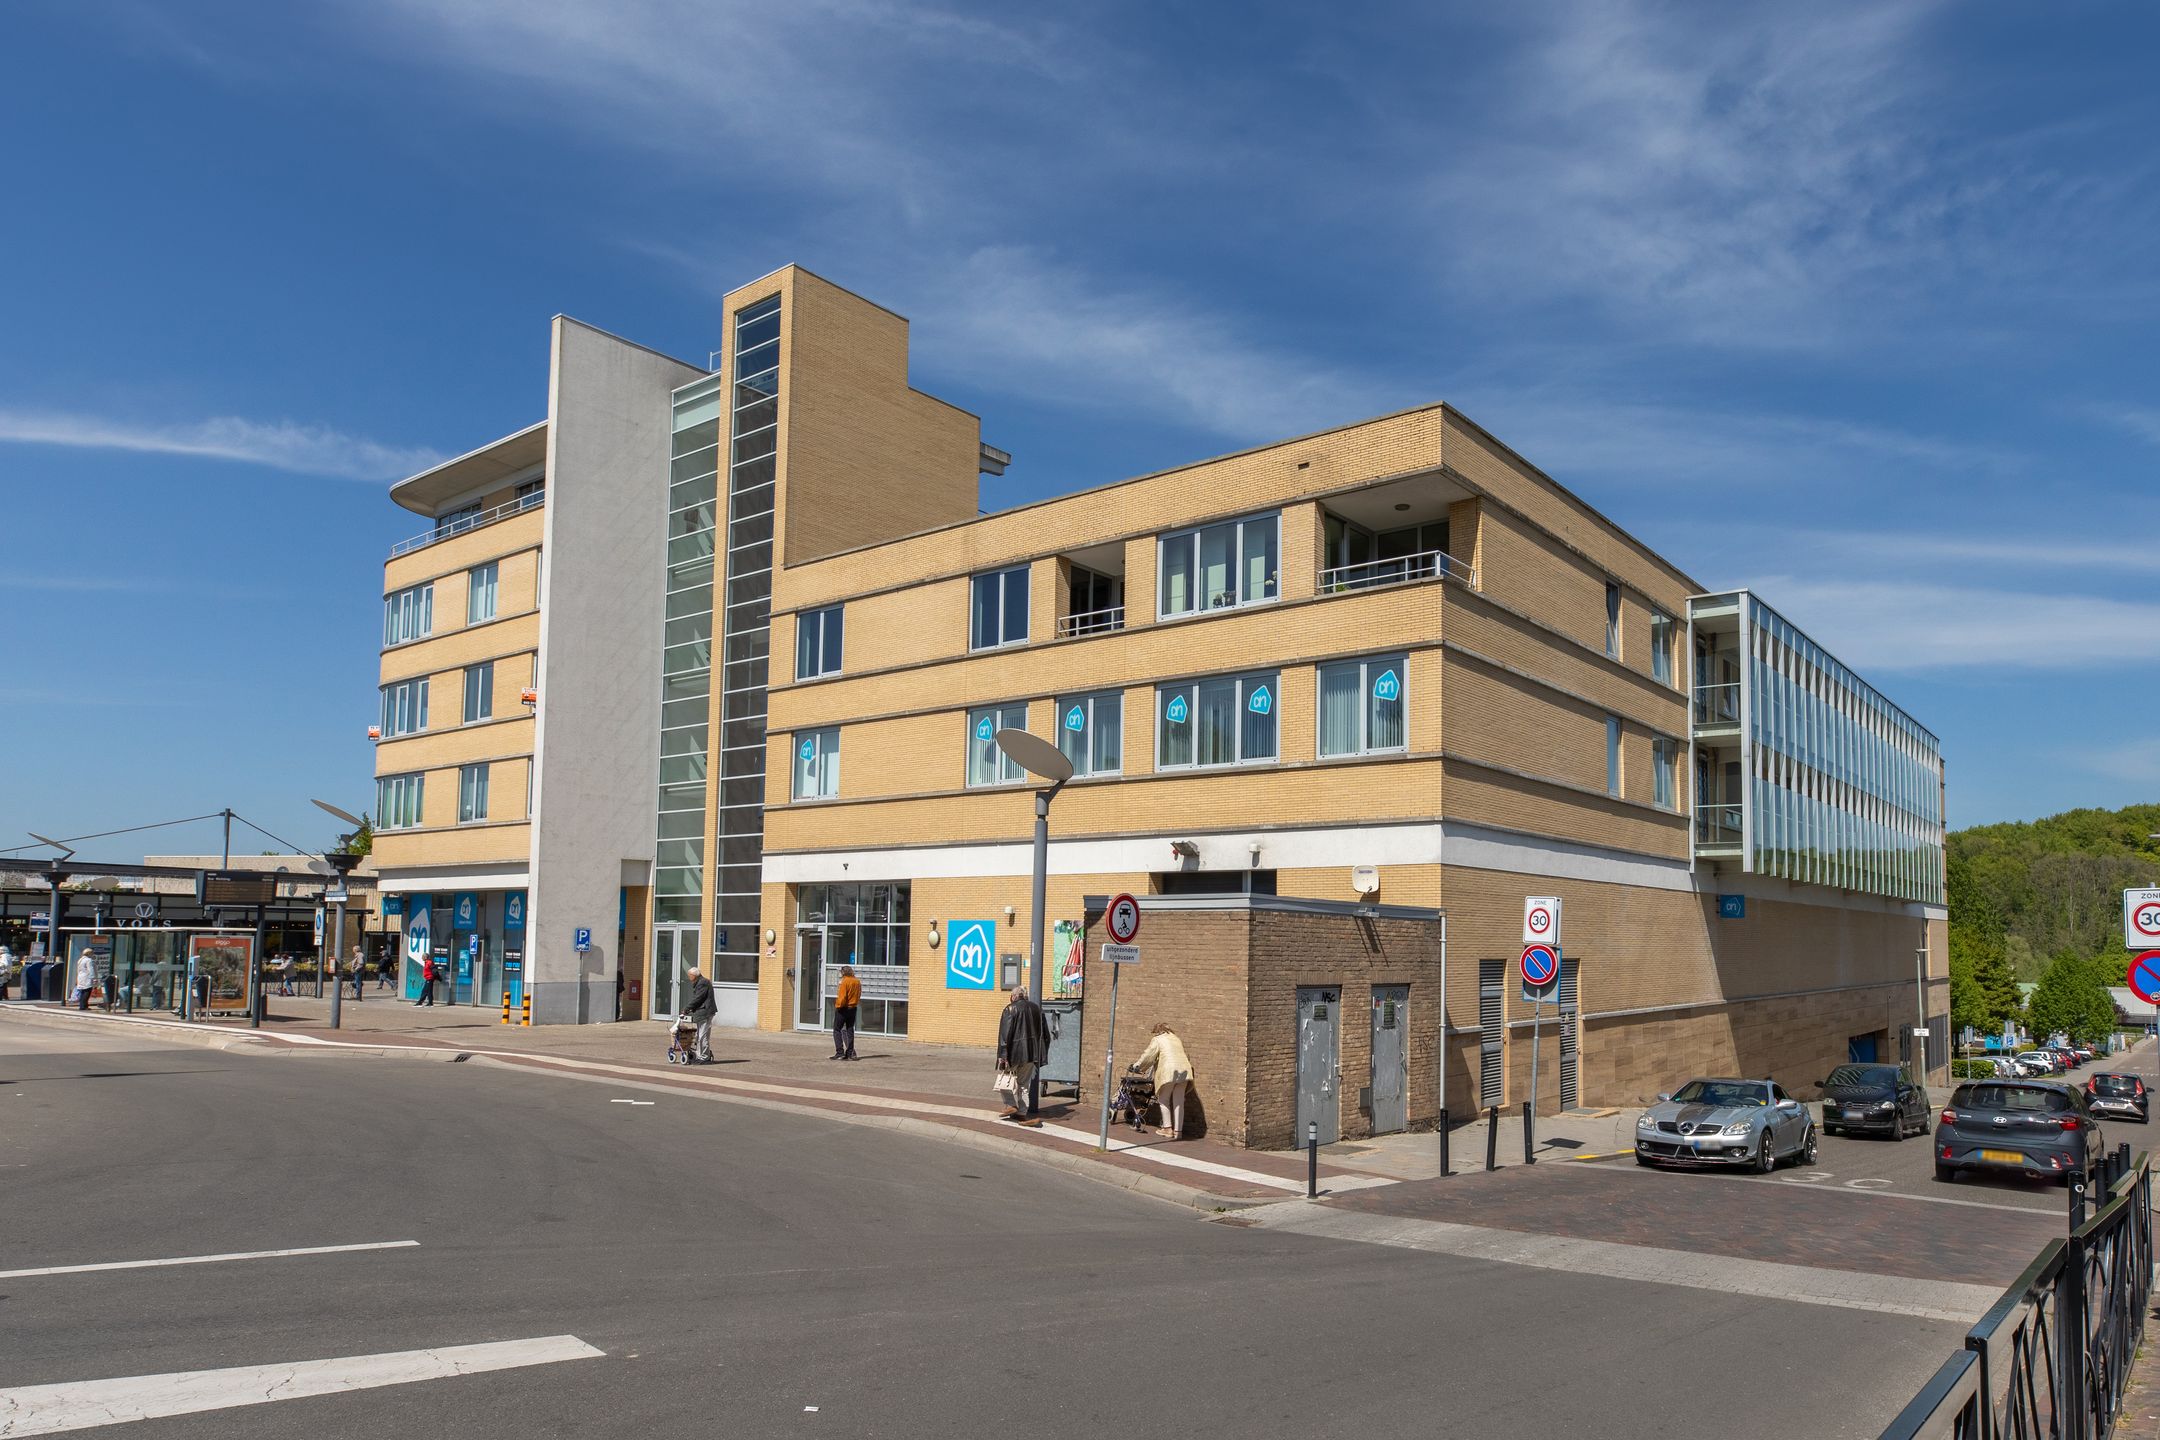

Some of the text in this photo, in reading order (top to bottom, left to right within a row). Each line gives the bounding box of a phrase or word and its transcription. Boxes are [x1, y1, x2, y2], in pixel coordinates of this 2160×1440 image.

[116, 919, 172, 928] VOLS
[1532, 915, 1547, 926] 30
[471, 936, 476, 945] P
[579, 930, 588, 942] P
[1106, 946, 1139, 954] uitgezonderd
[1109, 953, 1135, 961] lijnbussen
